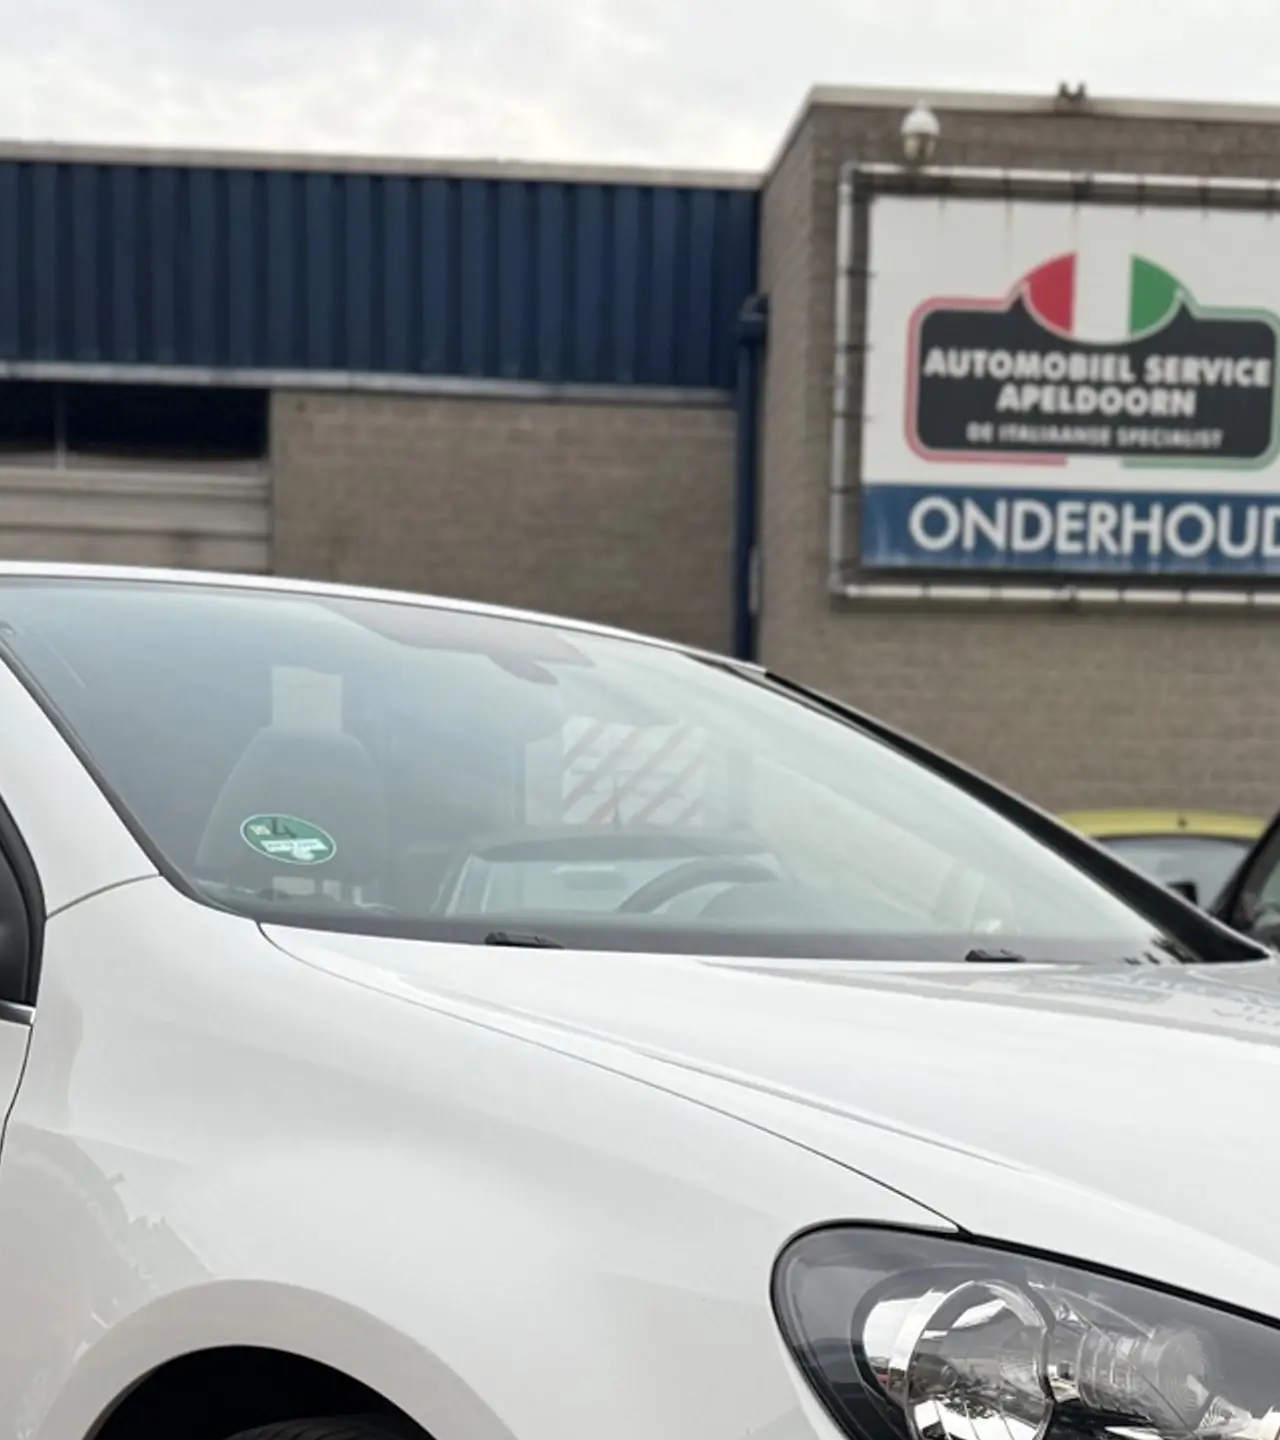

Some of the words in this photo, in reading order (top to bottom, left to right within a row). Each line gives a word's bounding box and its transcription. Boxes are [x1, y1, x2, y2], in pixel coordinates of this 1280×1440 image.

[923, 347, 1135, 383] AUTOMOBIEL
[1144, 354, 1271, 387] SERVICE
[996, 384, 1196, 417] APELDOORN
